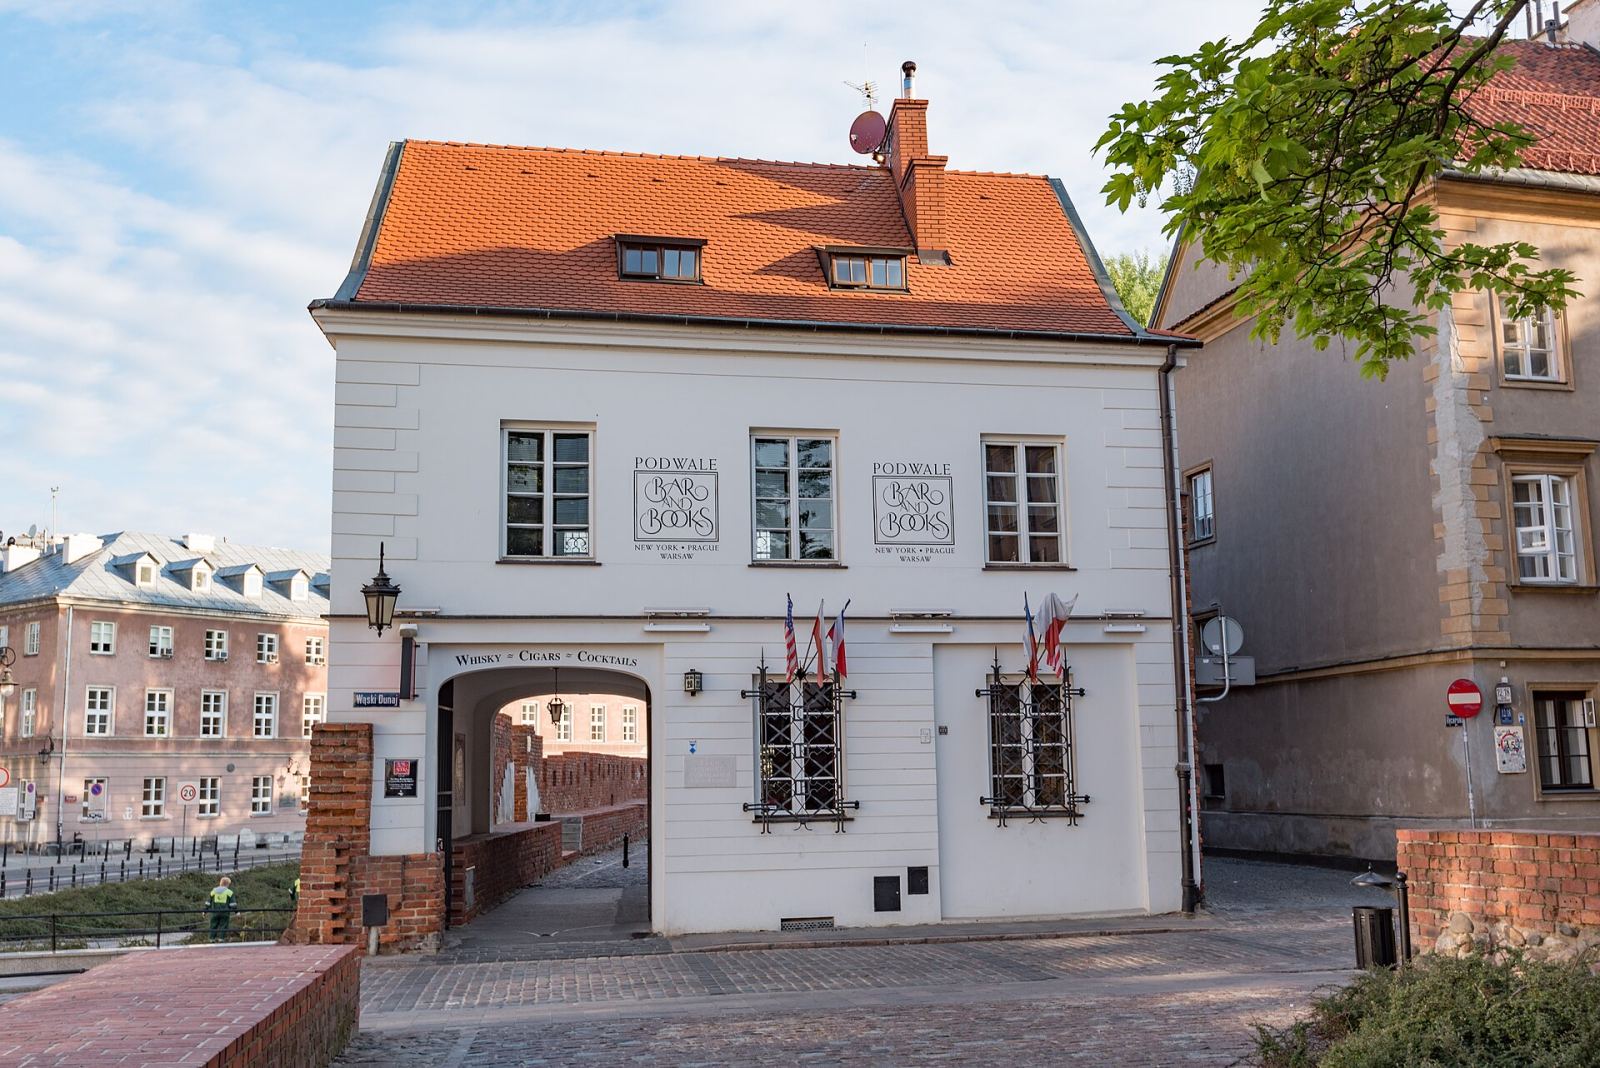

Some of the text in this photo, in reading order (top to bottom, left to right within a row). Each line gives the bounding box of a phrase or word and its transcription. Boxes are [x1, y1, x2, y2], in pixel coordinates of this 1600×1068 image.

[635, 456, 718, 471] PODWALE
[873, 462, 951, 476] PODWALE
[644, 476, 709, 503] BAR
[661, 483, 693, 511] AND
[882, 481, 944, 508] BAR
[898, 488, 929, 515] AND
[639, 506, 714, 537] BOOKS
[879, 510, 950, 540] BOOKS
[356, 694, 398, 707] Wąski Dunaj
[183, 789, 194, 797] 20
